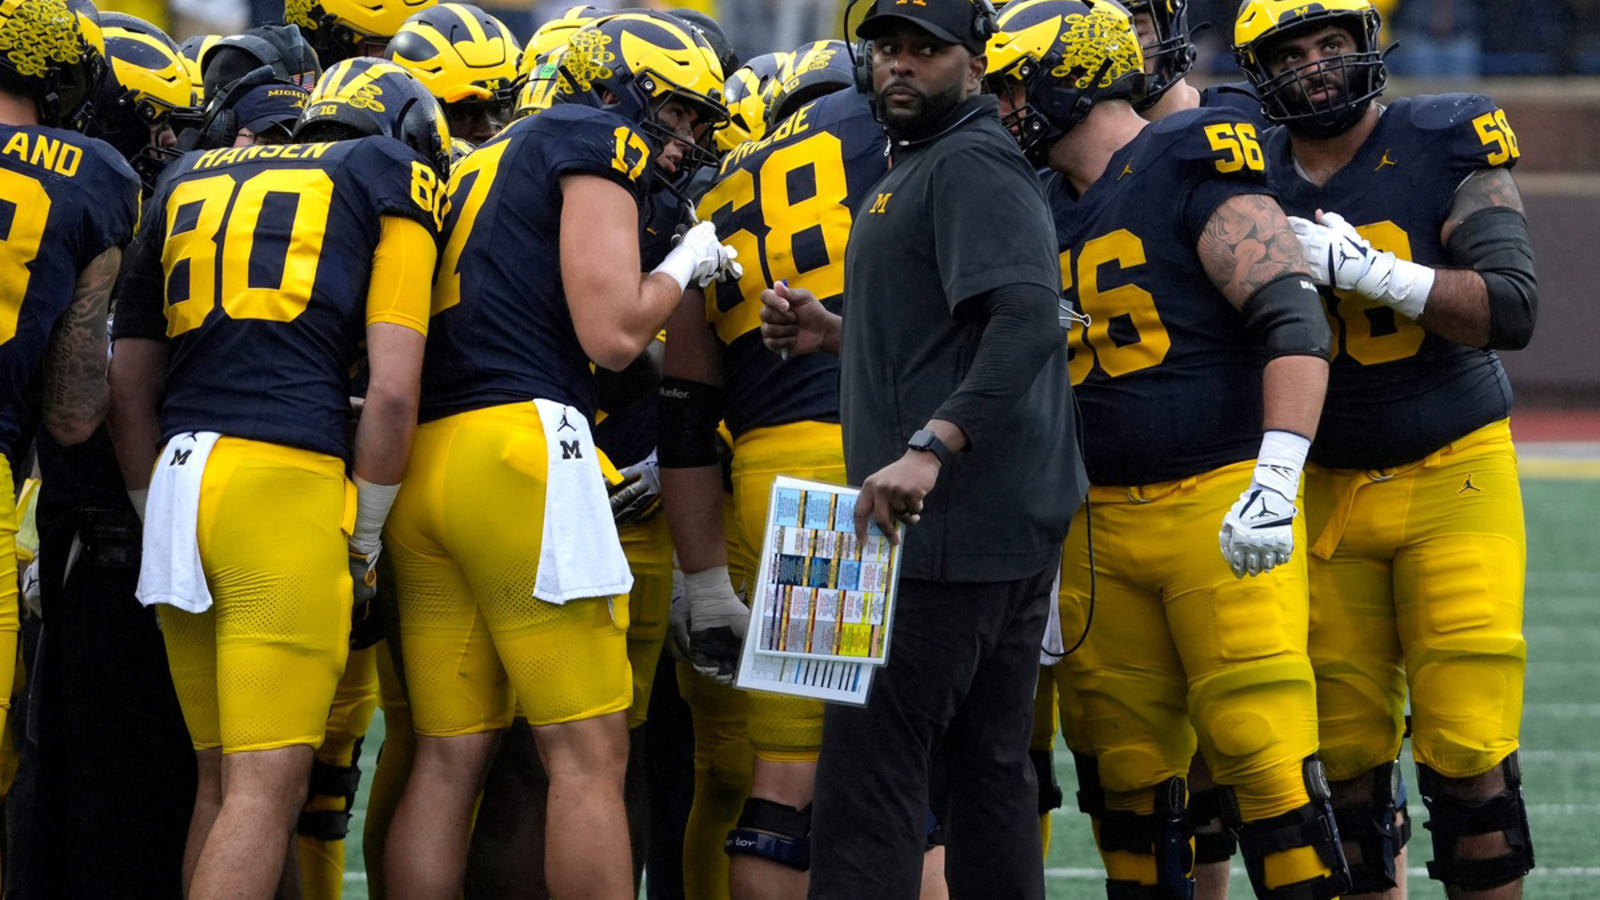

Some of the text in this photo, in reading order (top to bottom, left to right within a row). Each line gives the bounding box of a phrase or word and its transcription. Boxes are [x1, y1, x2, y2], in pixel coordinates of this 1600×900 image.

[485, 79, 500, 91] M
[192, 141, 338, 170] HANSEN
[612, 126, 650, 182] 17
[1204, 123, 1265, 173] 56
[1472, 109, 1520, 166] 58
[411, 160, 452, 232] 80
[869, 193, 892, 215] M
[160, 169, 334, 338] 80
[692, 131, 852, 345] 68
[169, 449, 192, 466] M
[560, 440, 583, 460] M
